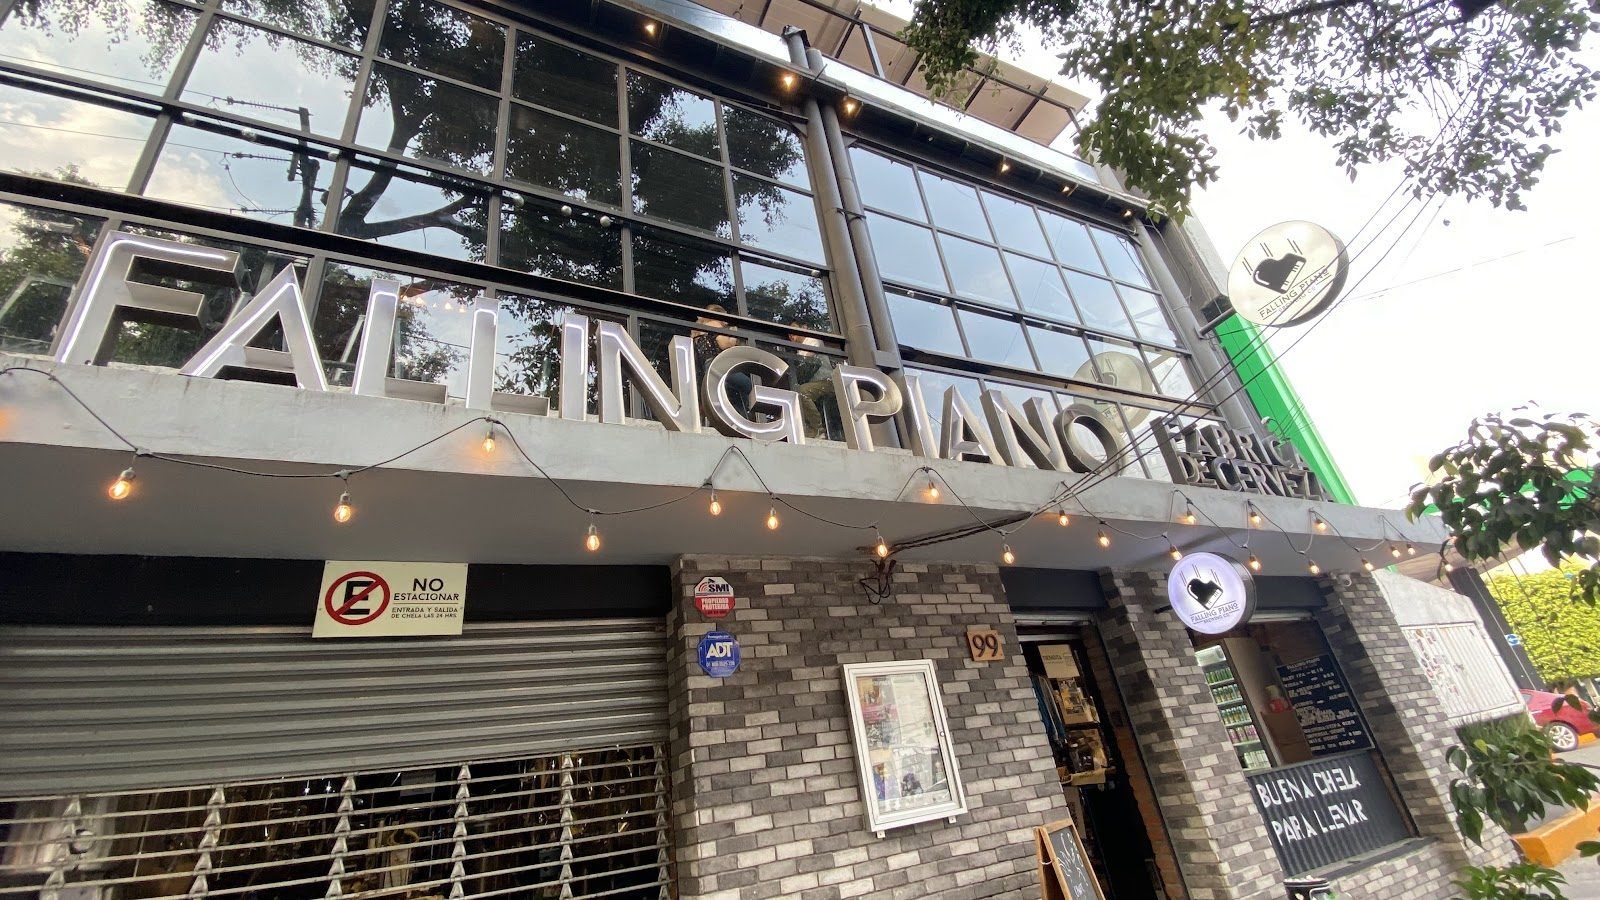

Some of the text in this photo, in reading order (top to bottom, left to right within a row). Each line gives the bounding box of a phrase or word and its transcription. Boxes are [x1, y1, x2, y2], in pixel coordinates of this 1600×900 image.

[1259, 289, 1298, 318] FALLING
[1299, 268, 1330, 292] PIANO
[56, 232, 1126, 477] FALLING PIANO
[412, 578, 444, 592] NO
[708, 583, 730, 593] SMI
[393, 593, 459, 601] ESTACIONAR
[1190, 602, 1239, 622] FALLING PIANO
[706, 641, 734, 659] ADT
[972, 634, 999, 658] 99
[1256, 765, 1362, 808] BUENA CHELA
[1271, 814, 1317, 846] PARA
